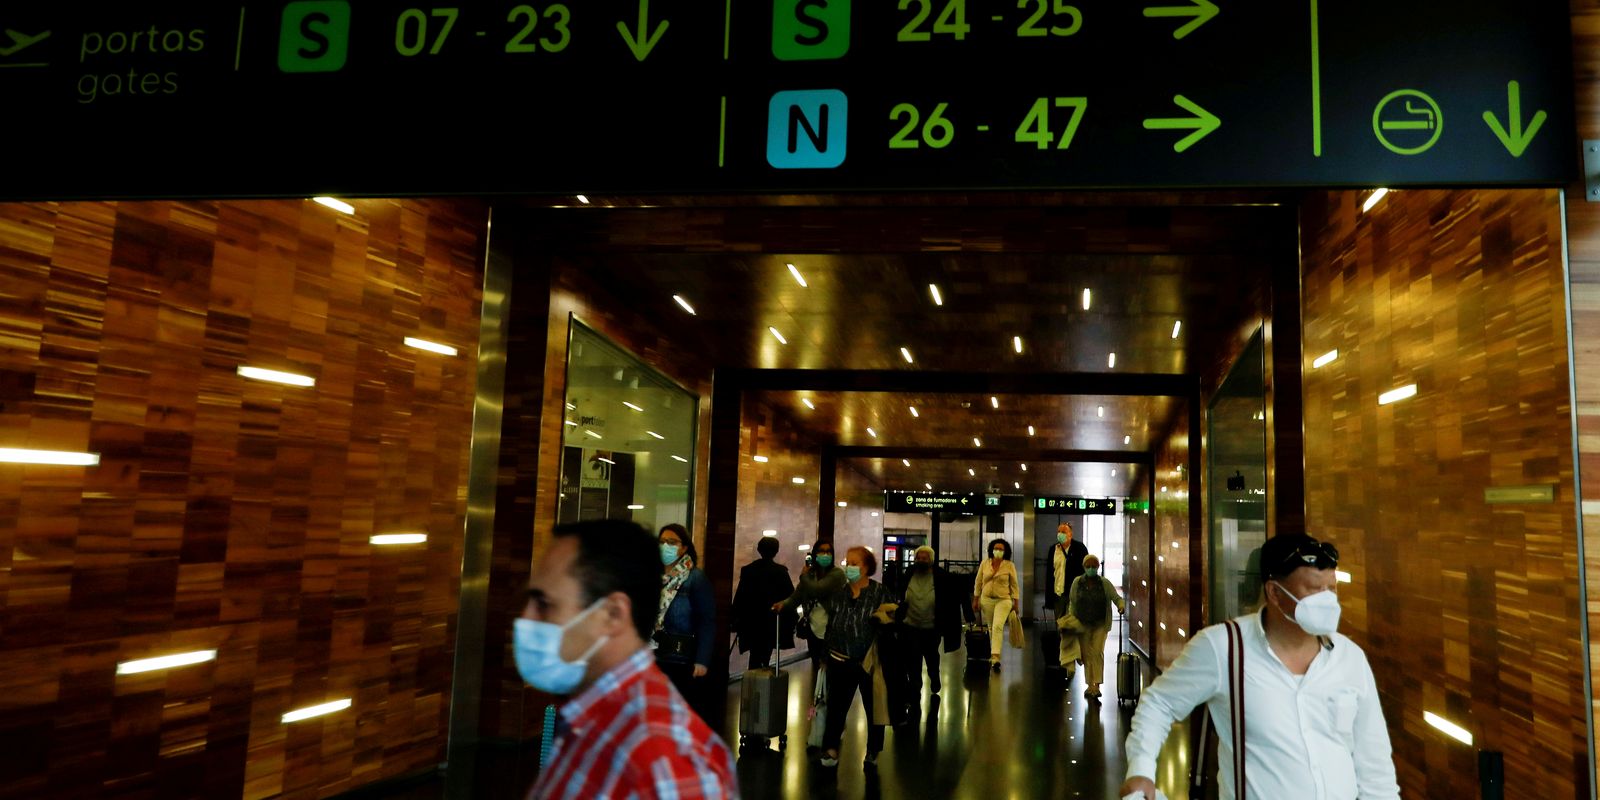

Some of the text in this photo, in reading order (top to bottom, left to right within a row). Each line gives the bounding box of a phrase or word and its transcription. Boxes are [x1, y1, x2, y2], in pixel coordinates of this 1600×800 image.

[80, 25, 205, 61] portas
[298, 12, 331, 60] S
[395, 8, 458, 56] 07
[506, 4, 571, 53] 23
[796, 0, 829, 46] S
[897, 0, 970, 41] 24
[1017, 0, 1083, 37] 25
[77, 68, 178, 104] gates
[787, 103, 829, 154] N
[888, 102, 955, 149] 26
[1014, 96, 1087, 149] 47
